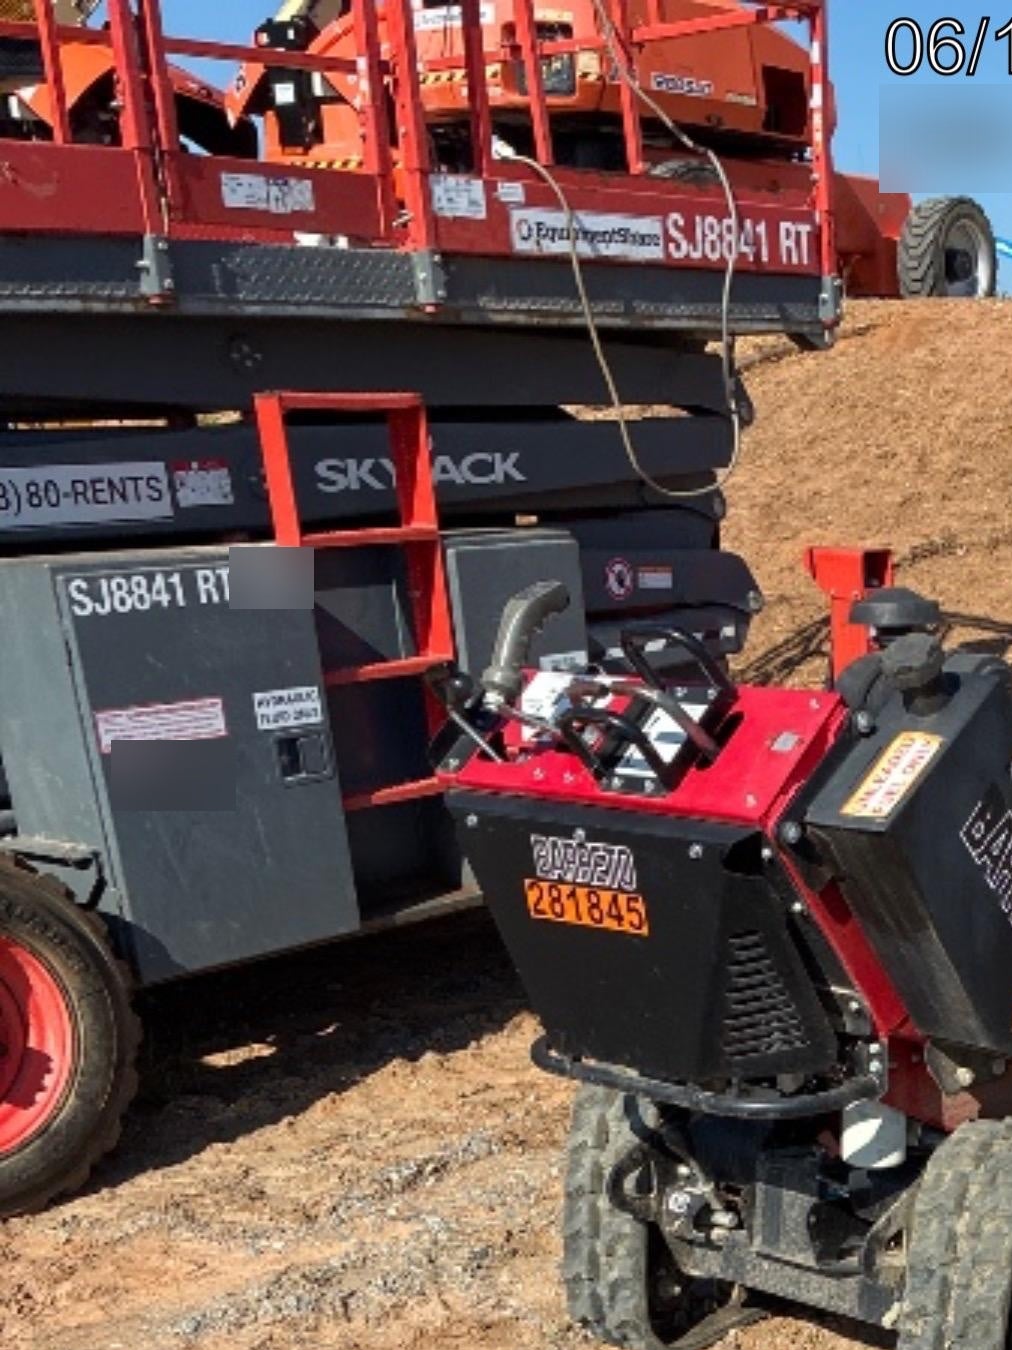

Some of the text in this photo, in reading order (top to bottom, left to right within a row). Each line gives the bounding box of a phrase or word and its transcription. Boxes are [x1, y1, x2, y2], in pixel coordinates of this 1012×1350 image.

[668, 212, 768, 263] SJ8841
[779, 221, 811, 264] RT
[314, 452, 527, 493] SKYACK
[68, 572, 186, 616] SJ8841
[527, 881, 643, 931] 281845
